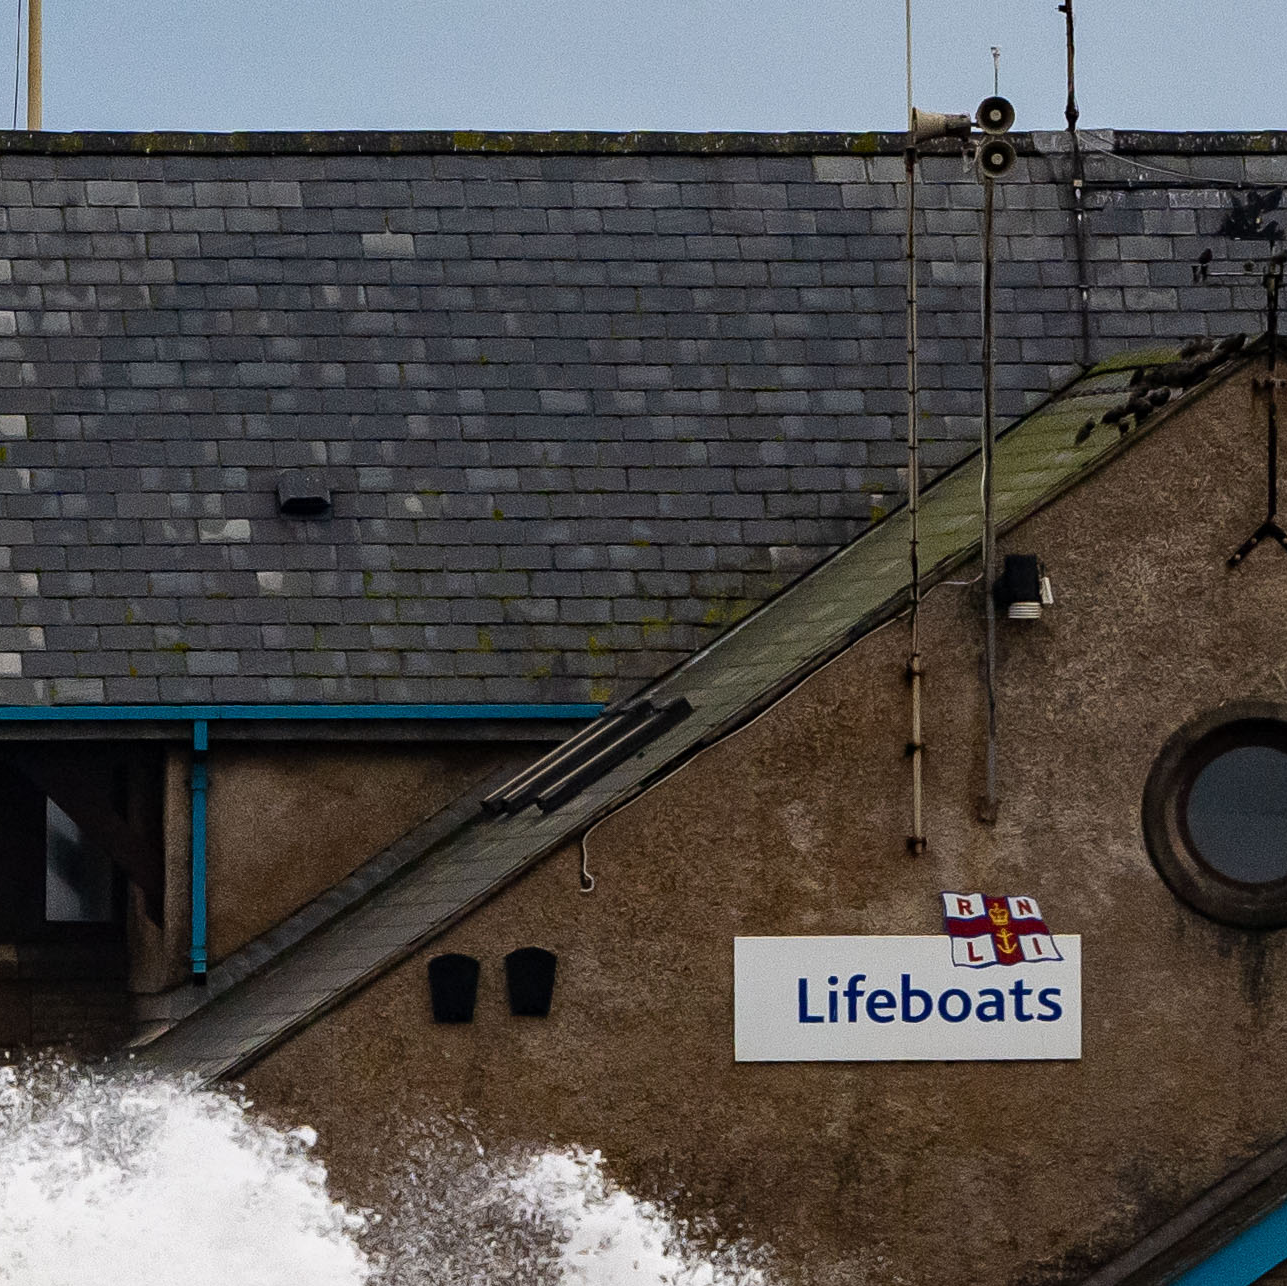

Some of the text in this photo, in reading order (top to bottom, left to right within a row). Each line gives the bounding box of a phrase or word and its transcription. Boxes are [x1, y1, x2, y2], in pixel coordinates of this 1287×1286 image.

[957, 898, 1033, 916] R N
[966, 941, 984, 962] L
[797, 974, 1063, 1023] Lifeboats
